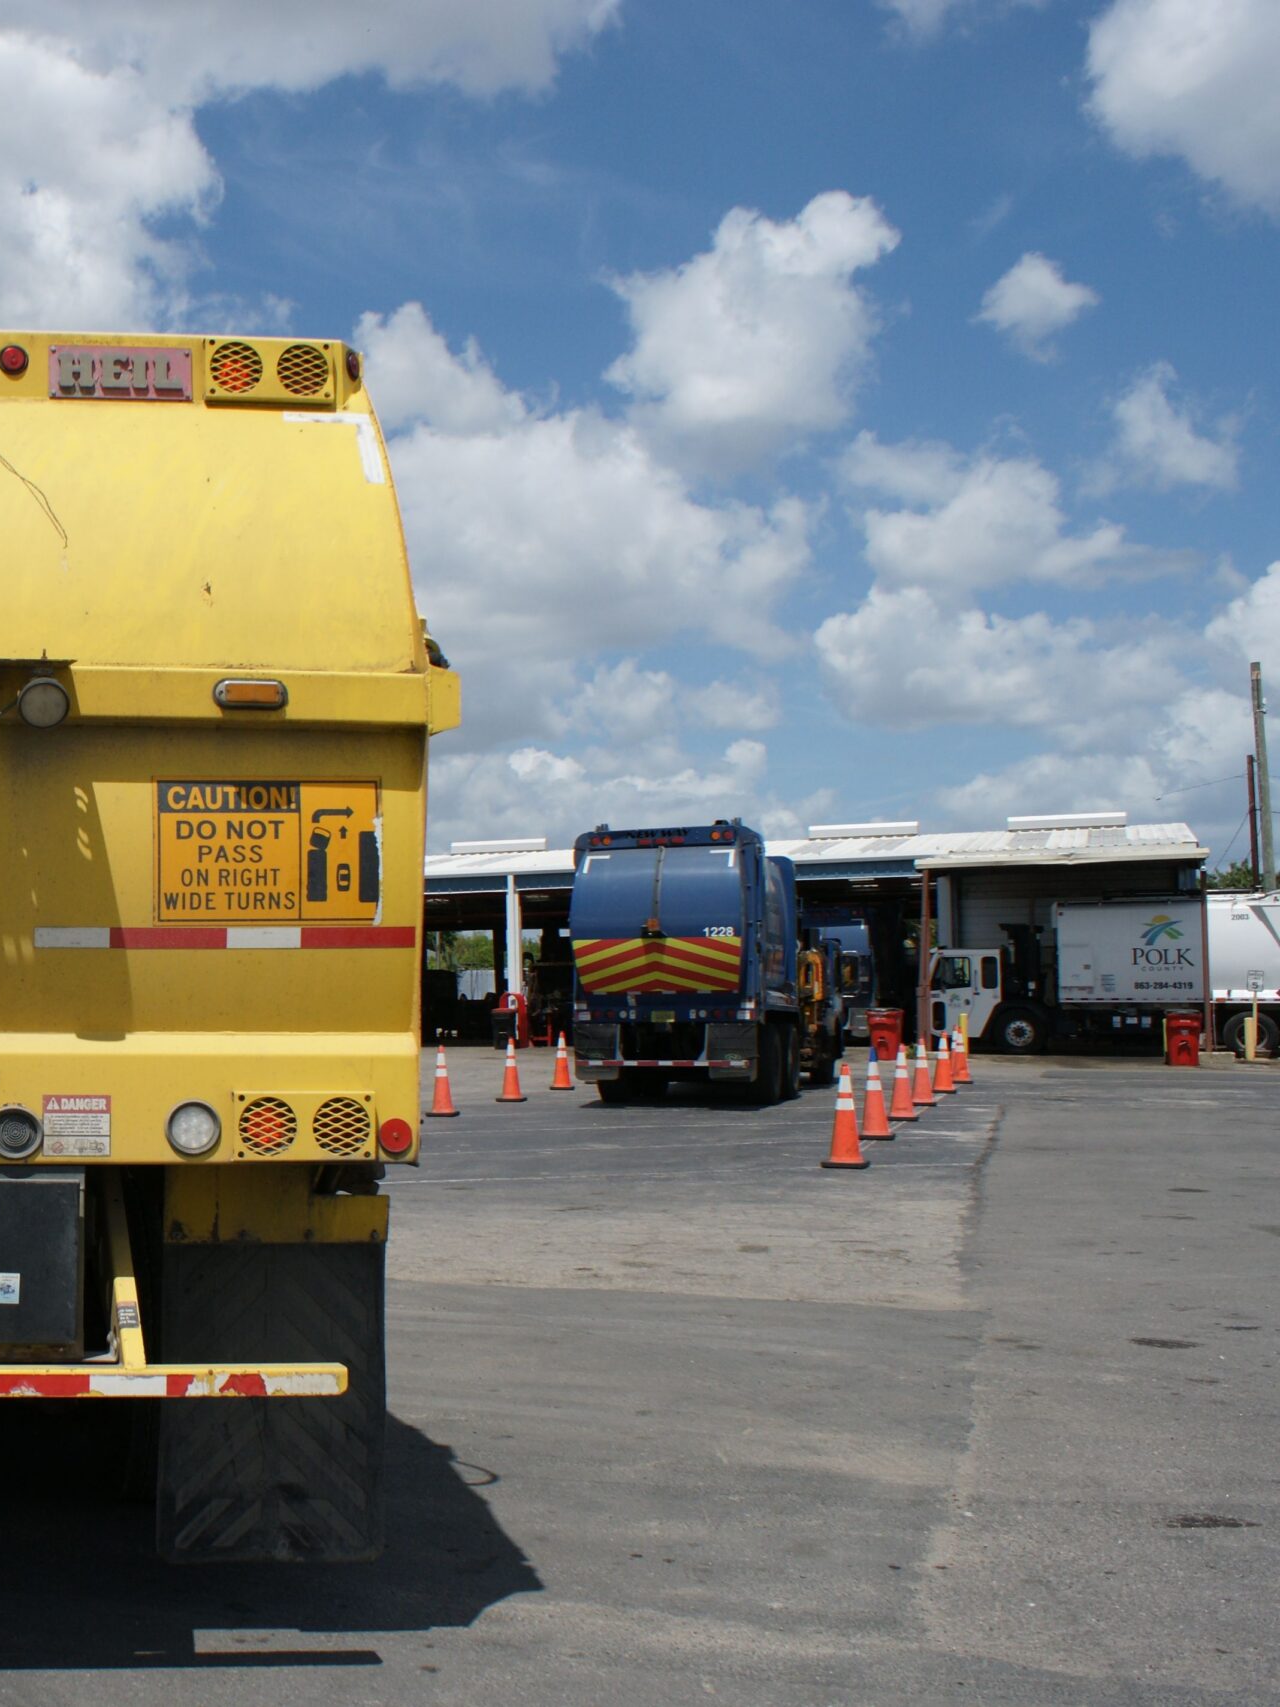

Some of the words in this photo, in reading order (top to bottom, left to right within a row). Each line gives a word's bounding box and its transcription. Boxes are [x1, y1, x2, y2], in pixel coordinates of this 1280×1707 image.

[57, 352, 184, 394] HEIL
[167, 785, 297, 810] CAUTION!
[176, 820, 217, 840] DO
[226, 820, 285, 840] NOT
[198, 845, 263, 863] PASS
[181, 868, 209, 887] ON
[218, 868, 280, 887] RIGHT
[164, 892, 216, 911] WIDE
[224, 892, 296, 911] TURNS
[703, 926, 735, 937] 1228
[1131, 948, 1195, 967] POLK
[1134, 982, 1194, 990] 863-284-4319
[60, 1098, 107, 1110] DANGER
